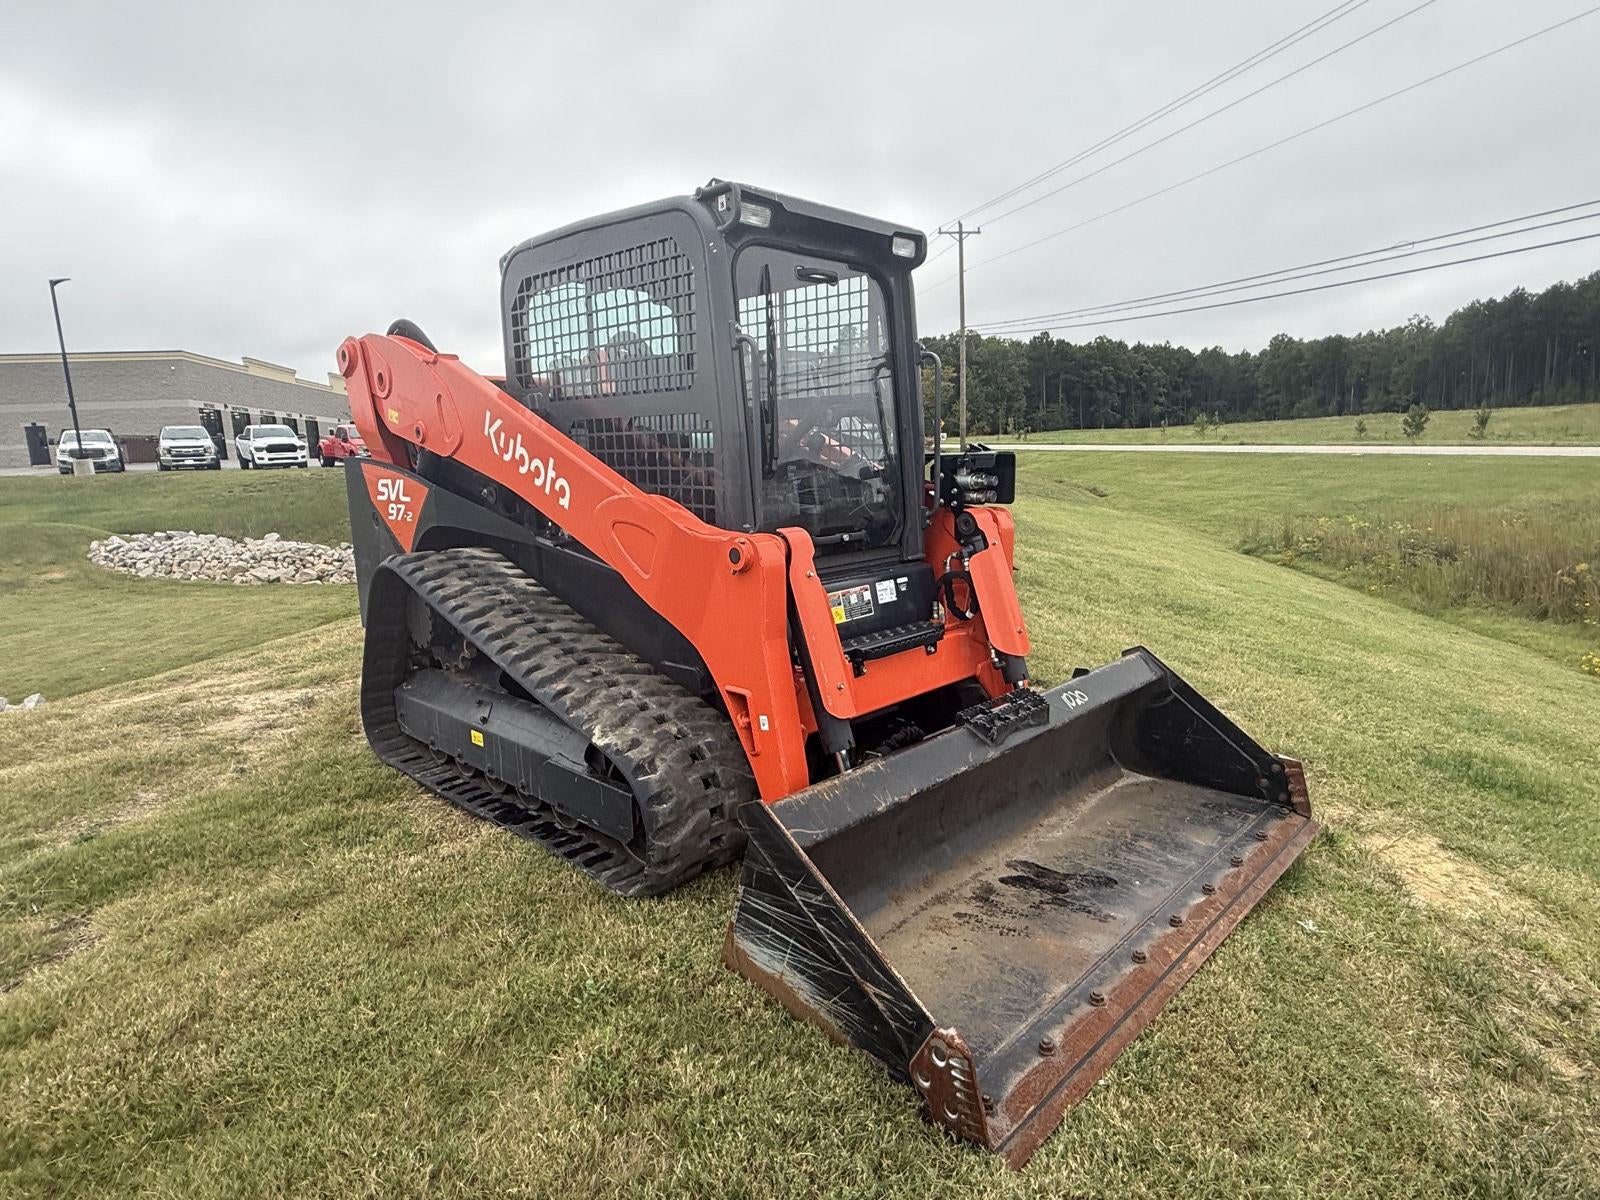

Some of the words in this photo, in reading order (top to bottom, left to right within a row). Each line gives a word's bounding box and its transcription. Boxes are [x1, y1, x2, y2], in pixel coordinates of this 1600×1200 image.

[484, 409, 570, 510] Kubota
[377, 478, 411, 502] SVL
[388, 503, 413, 522] 97-2
